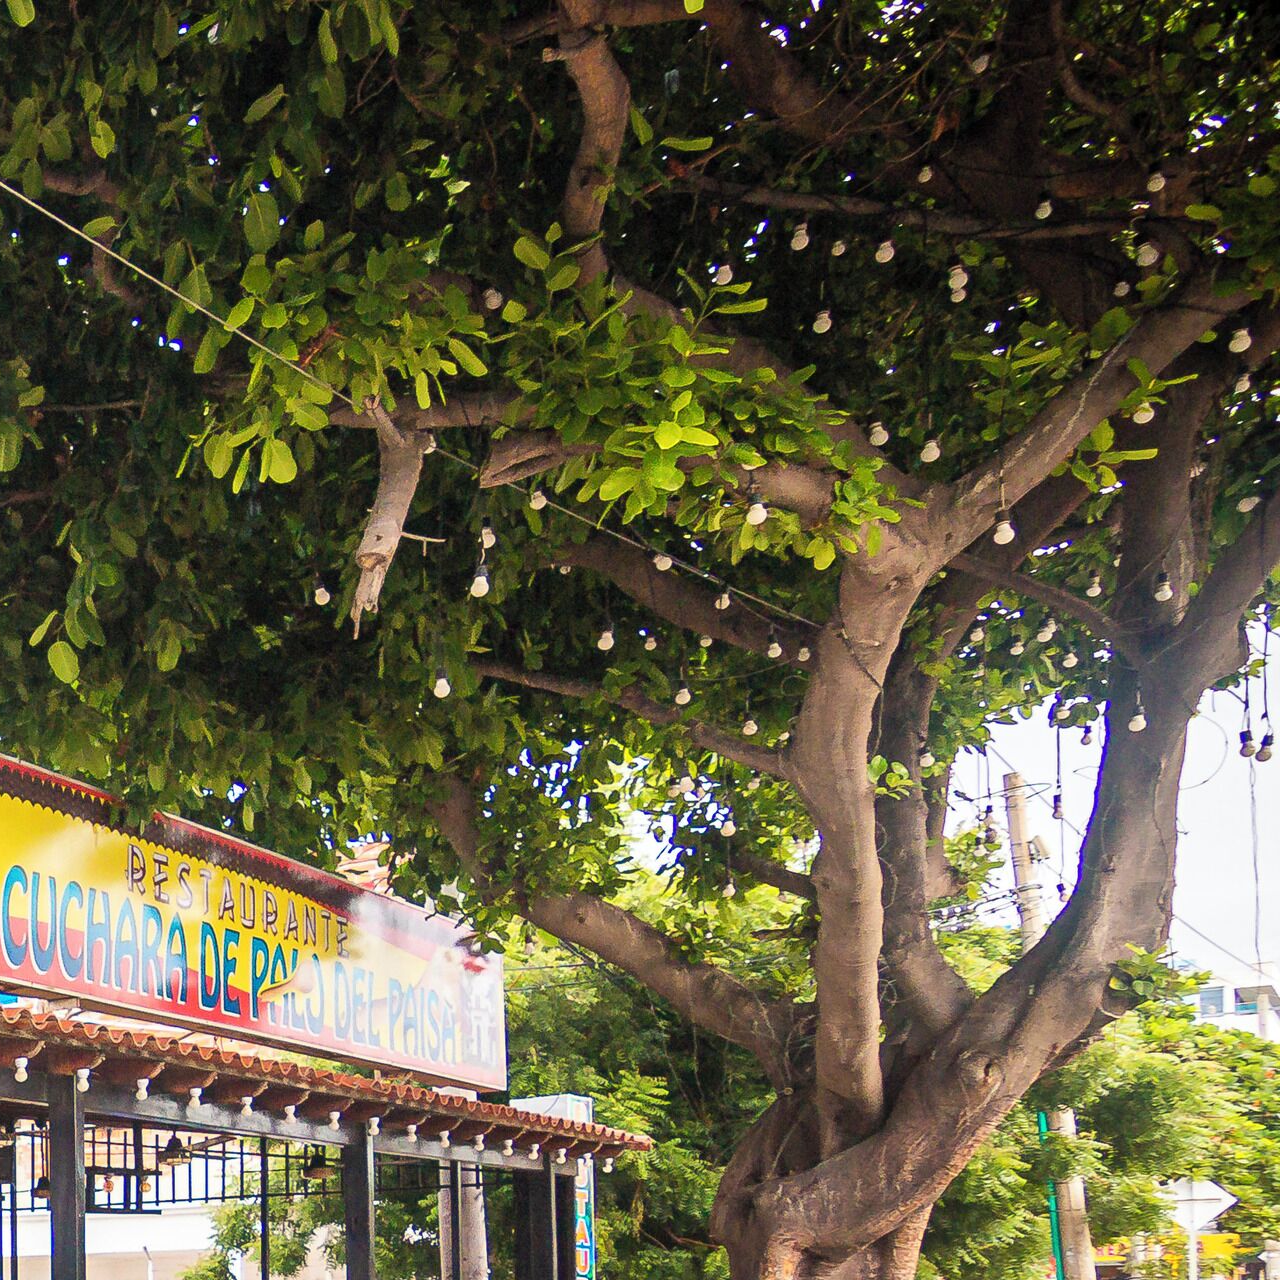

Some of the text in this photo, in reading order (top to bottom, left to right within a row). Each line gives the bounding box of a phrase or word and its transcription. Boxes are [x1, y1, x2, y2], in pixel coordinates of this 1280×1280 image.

[0, 865, 189, 1004] CUCHARA
[198, 921, 242, 1018] DE
[332, 960, 383, 1049] DEL
[126, 843, 350, 959] RESTAURANTE
